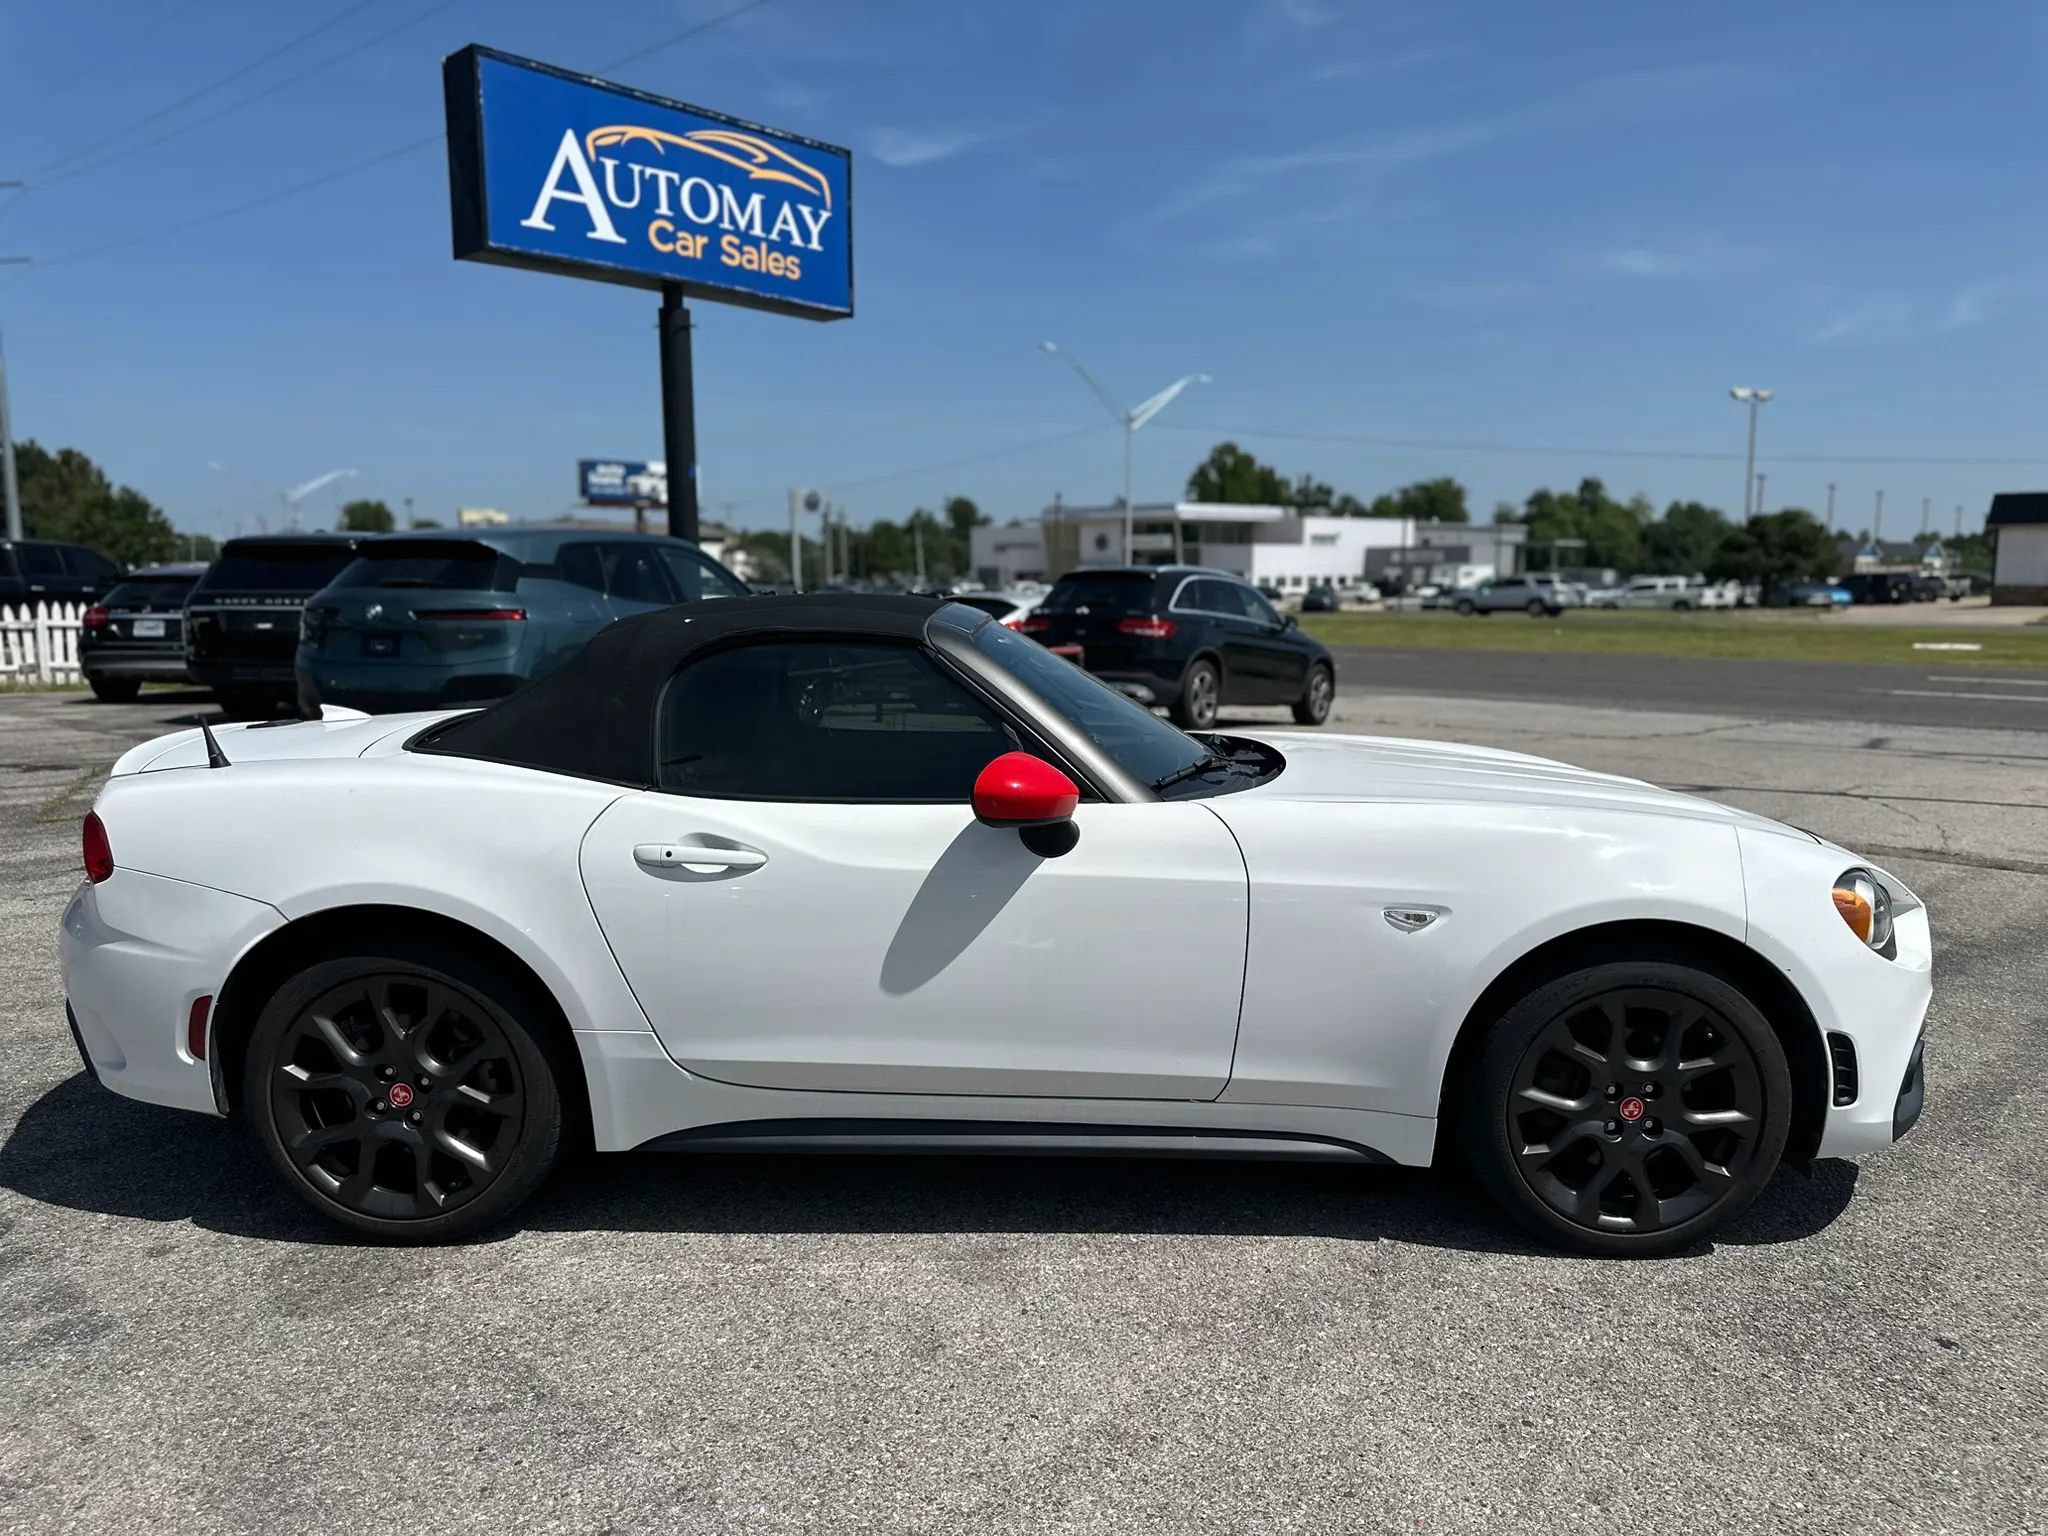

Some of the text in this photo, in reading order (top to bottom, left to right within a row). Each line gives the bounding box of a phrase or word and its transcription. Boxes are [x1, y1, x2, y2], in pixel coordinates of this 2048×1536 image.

[520, 128, 832, 250] AUTOMAY
[648, 220, 802, 280] Car Sales
